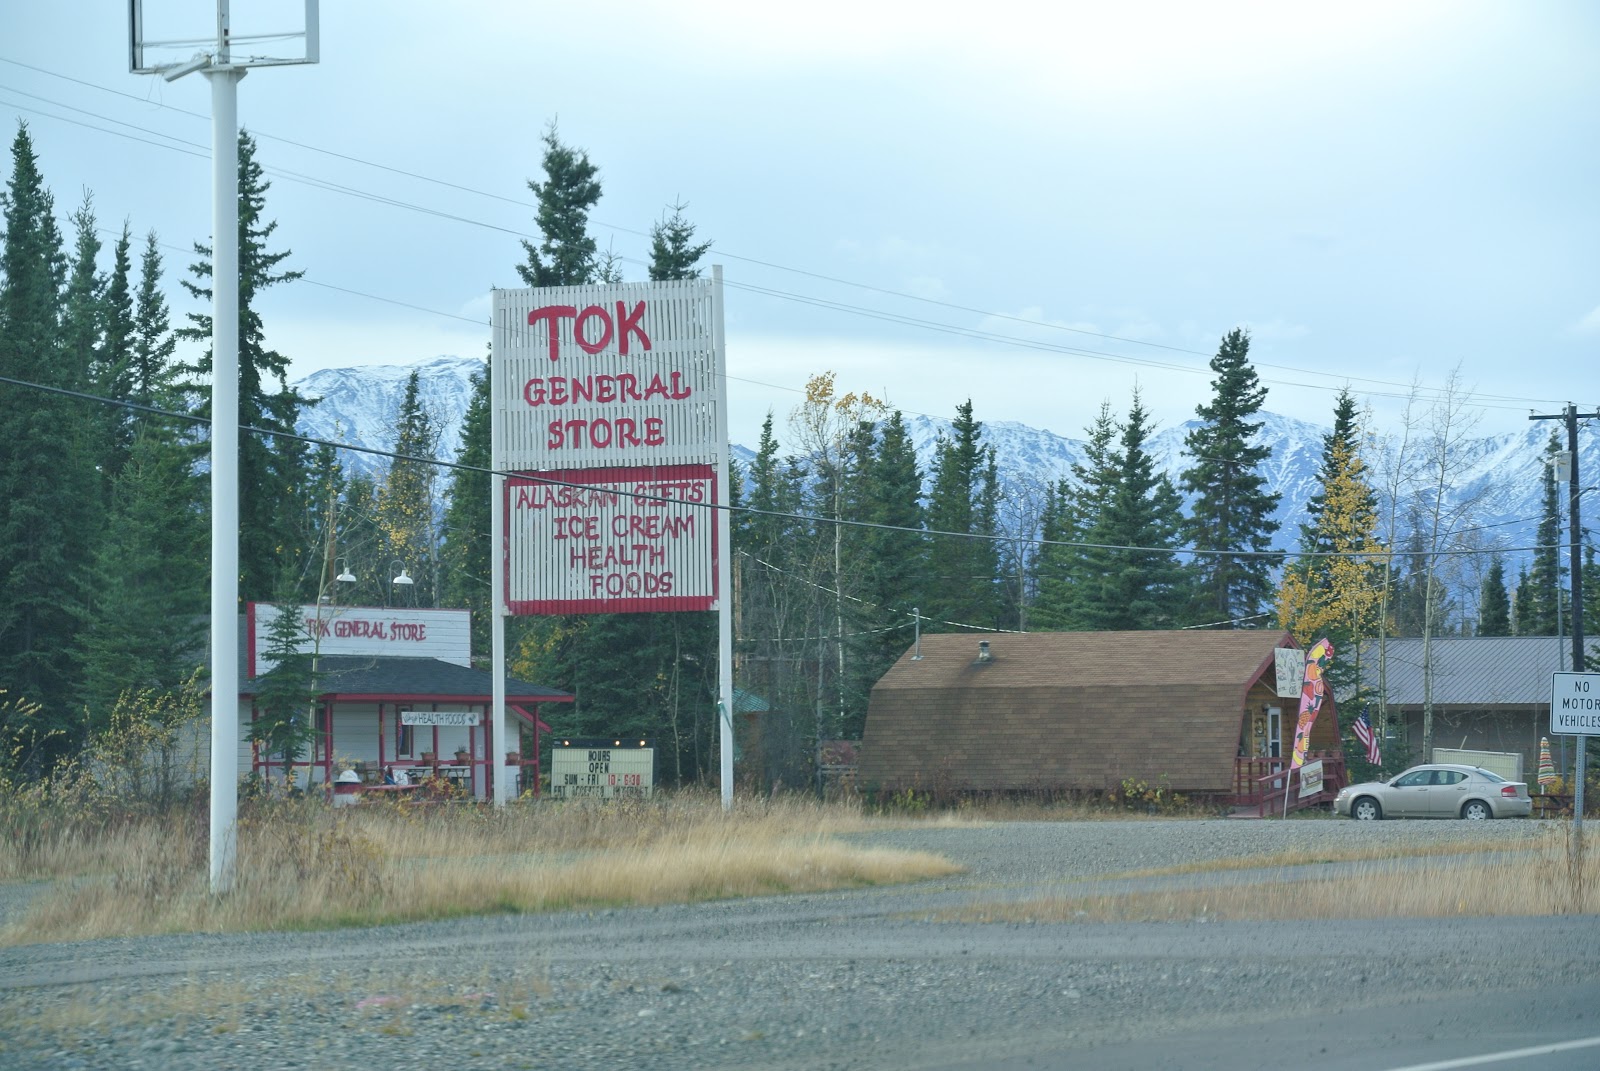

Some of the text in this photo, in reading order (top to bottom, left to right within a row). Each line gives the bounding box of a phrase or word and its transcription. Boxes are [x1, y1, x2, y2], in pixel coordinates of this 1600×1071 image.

[528, 300, 652, 362] TOK
[524, 371, 691, 407] GENERAL
[548, 417, 665, 450] STORE
[517, 481, 705, 510] ALASKAN GIFTS
[553, 514, 695, 541] ICE CREAM
[570, 544, 665, 570] HEALTH
[589, 571, 673, 597] FOODS
[334, 620, 388, 640] GENERAL
[390, 620, 427, 641] STORE
[1574, 681, 1590, 693] NO
[1562, 697, 1600, 710] MOTOR
[418, 712, 466, 725] HEALTH FOODS
[588, 750, 611, 762] HOURS
[589, 762, 609, 774] OPEN
[564, 774, 578, 785] SUN
[587, 774, 599, 785] FRI
[608, 774, 616, 786] 10
